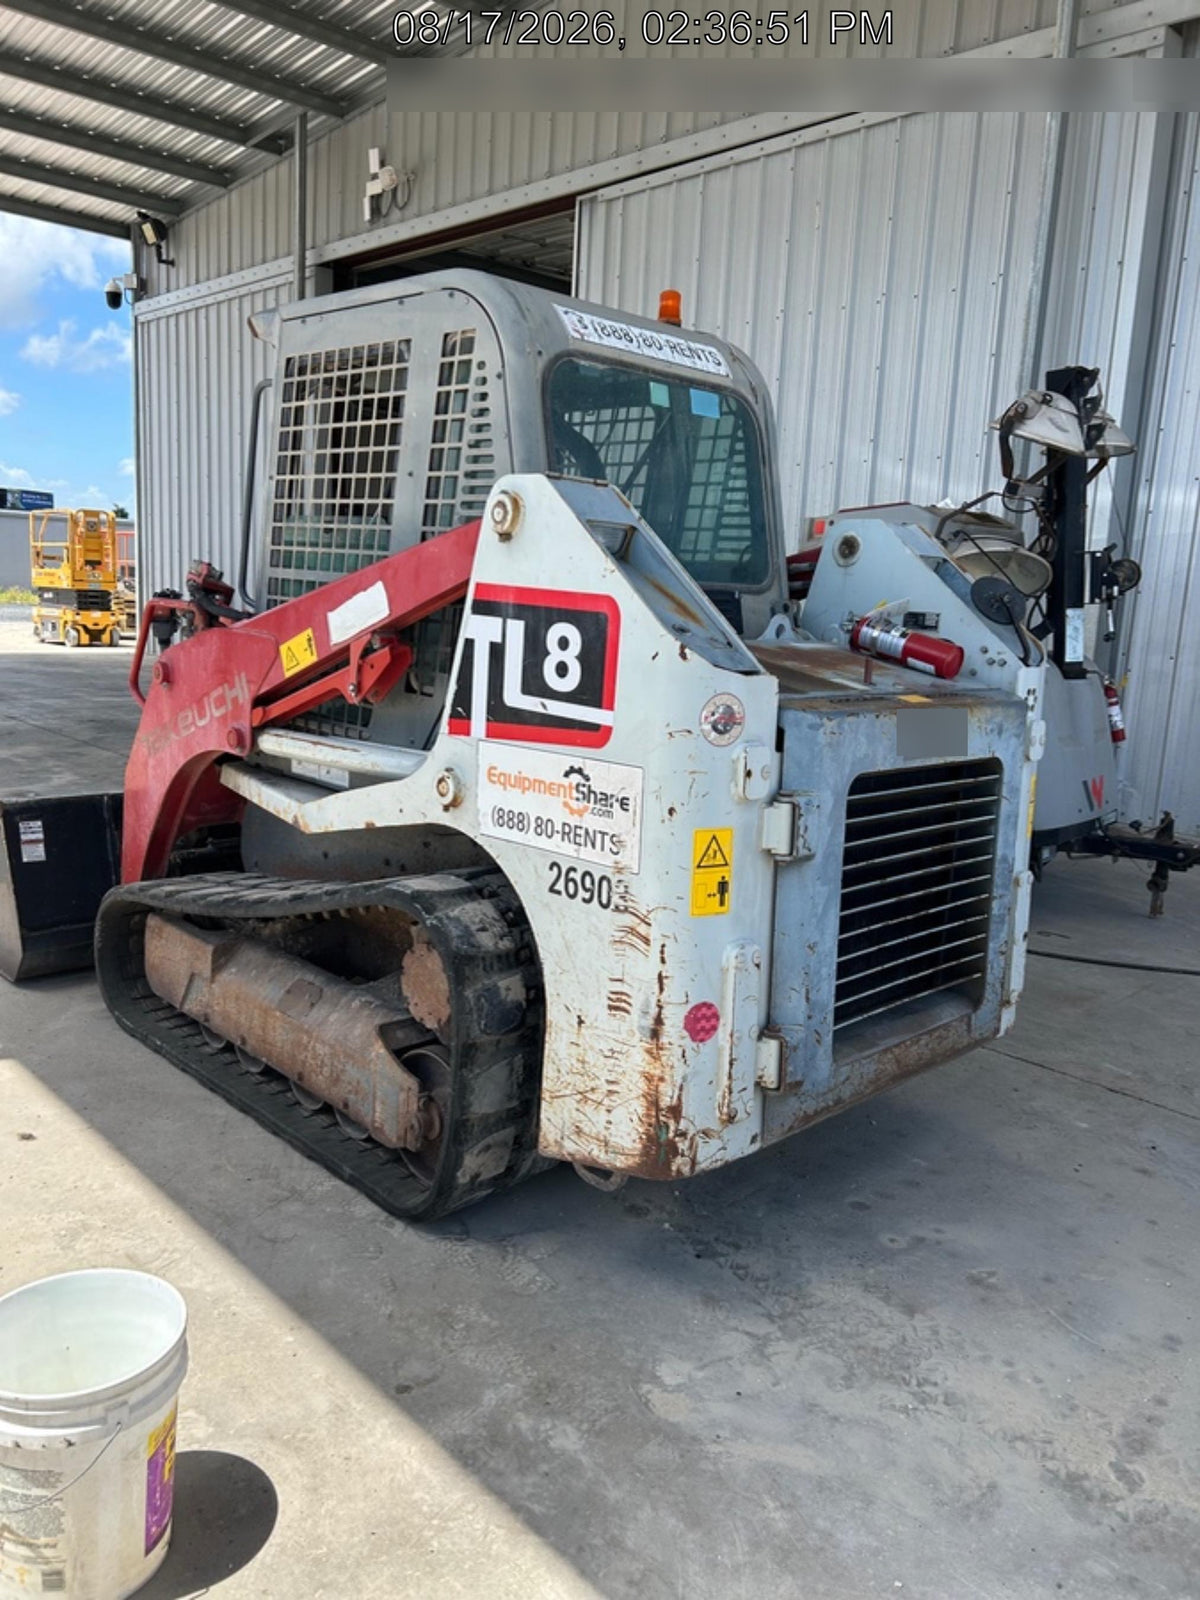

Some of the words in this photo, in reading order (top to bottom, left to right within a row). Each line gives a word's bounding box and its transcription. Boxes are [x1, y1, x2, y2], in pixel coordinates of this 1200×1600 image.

[463, 613, 614, 738] TL8
[491, 804, 531, 835] (888)
[534, 815, 622, 856] 80-RENTS
